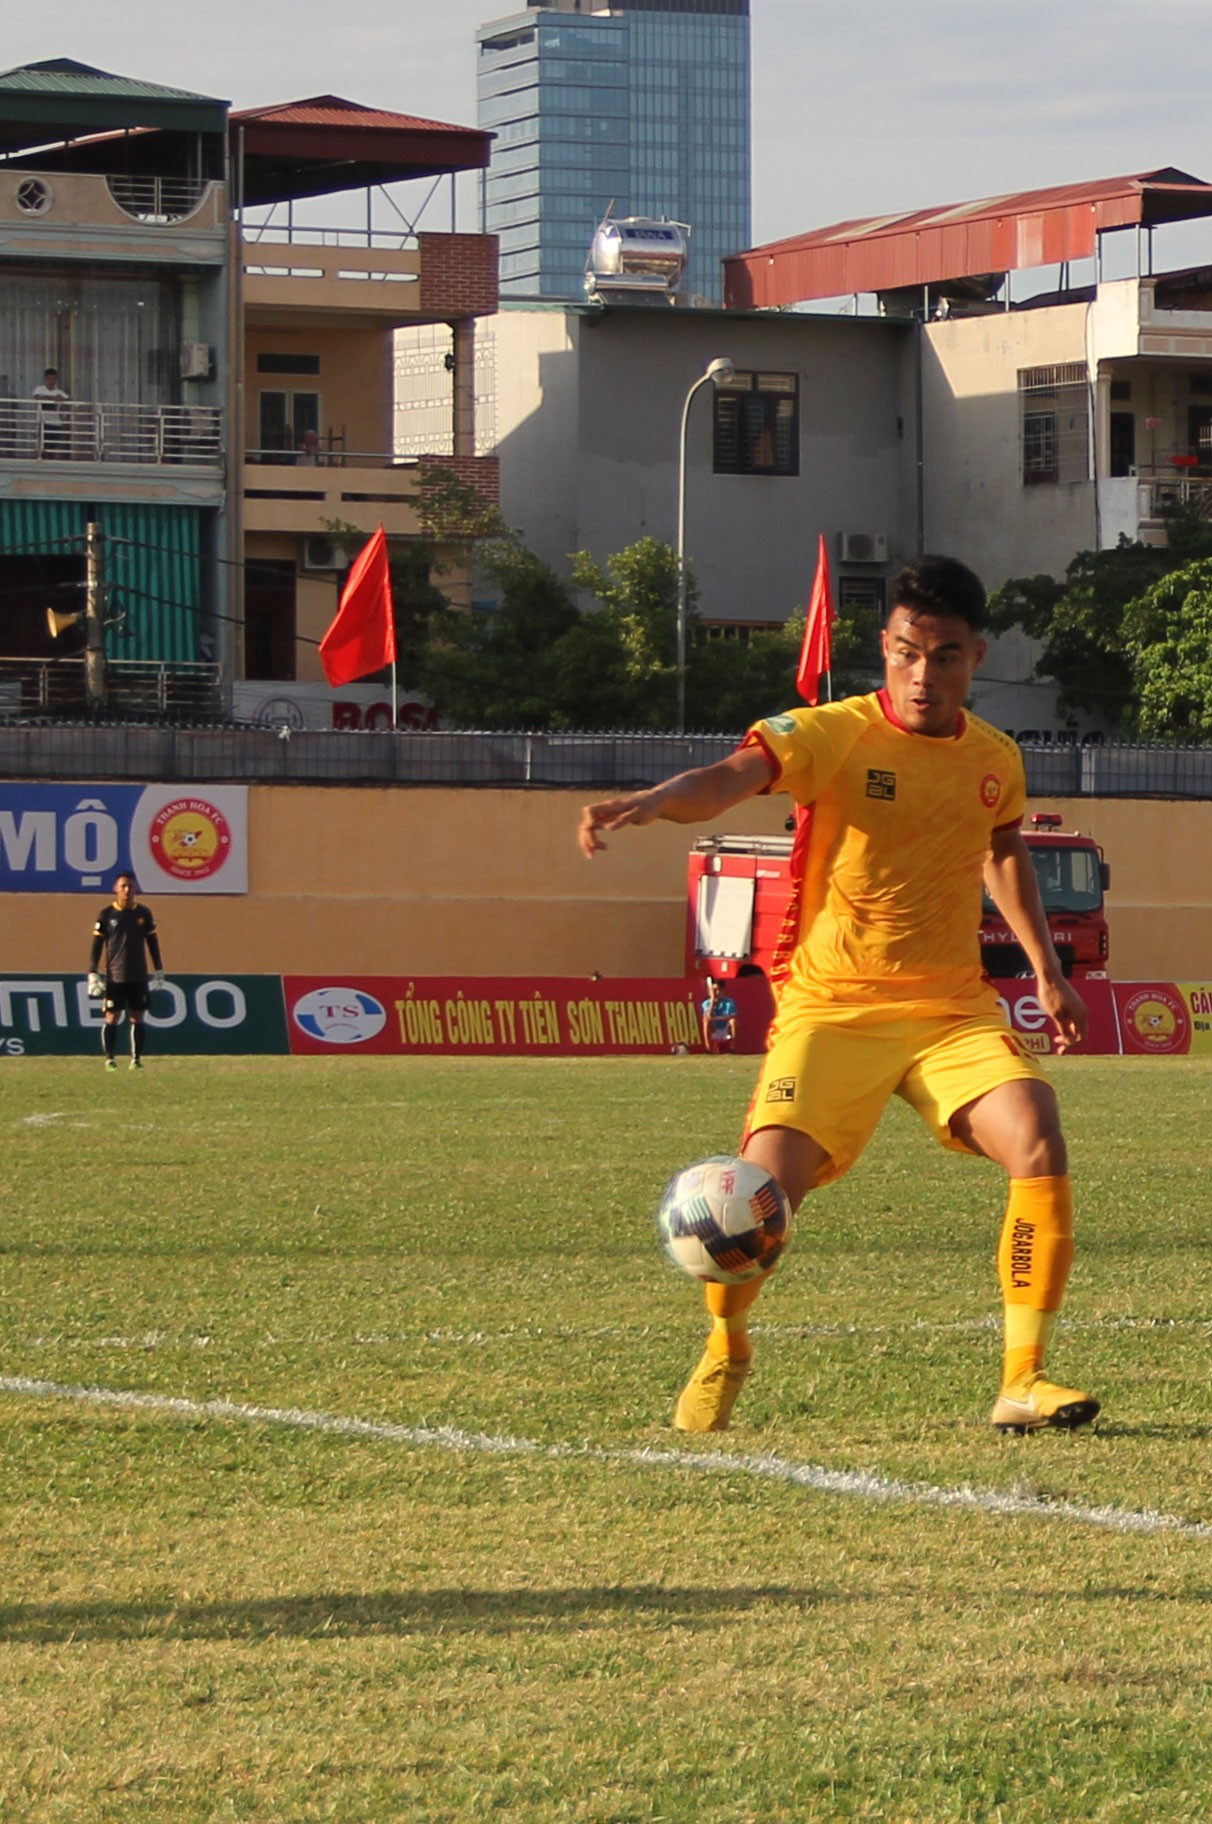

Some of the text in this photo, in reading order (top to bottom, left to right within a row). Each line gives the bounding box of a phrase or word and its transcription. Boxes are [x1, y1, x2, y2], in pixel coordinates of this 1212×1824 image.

[319, 1005, 359, 1018] TS
[395, 982, 443, 1044] TỔNG
[445, 990, 494, 1044] CÔNG
[496, 1000, 516, 1044] TY
[605, 1000, 664, 1045] THANH
[1012, 1217, 1036, 1288] JOGARBOLA
